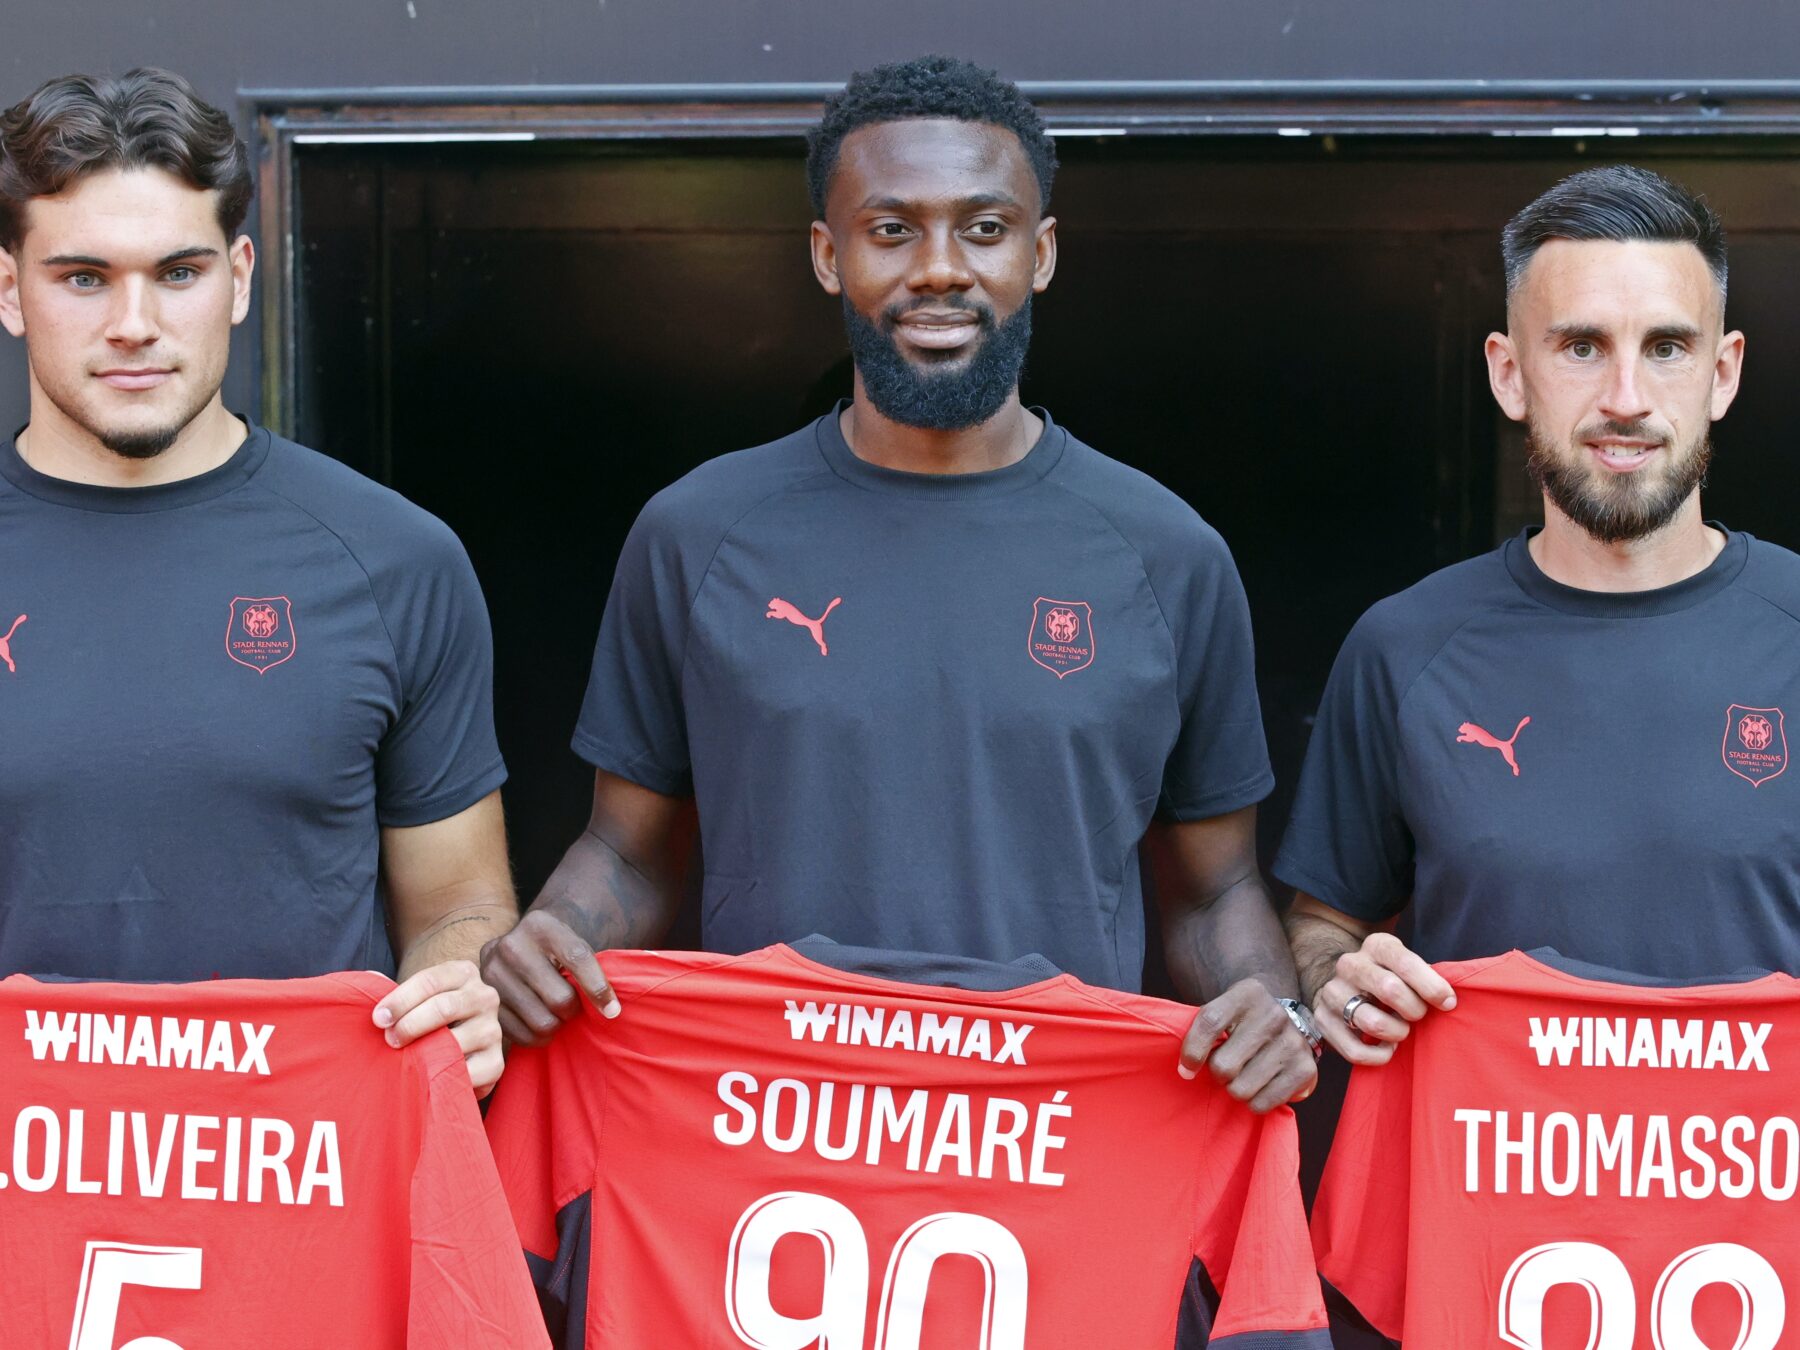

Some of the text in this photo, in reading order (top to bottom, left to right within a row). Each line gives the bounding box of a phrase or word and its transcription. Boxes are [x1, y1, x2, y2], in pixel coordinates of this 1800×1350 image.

[1035, 643, 1088, 655] STADE RENNAIS
[1729, 752, 1781, 762] STADE RENNAIS
[25, 1010, 275, 1075] WINAMAX
[784, 1001, 1034, 1065] WINAMAX
[1529, 1017, 1773, 1072] WINAMAX
[713, 1071, 1072, 1187] SOUMARÉ
[1454, 1108, 1800, 1202] THOMASSO
